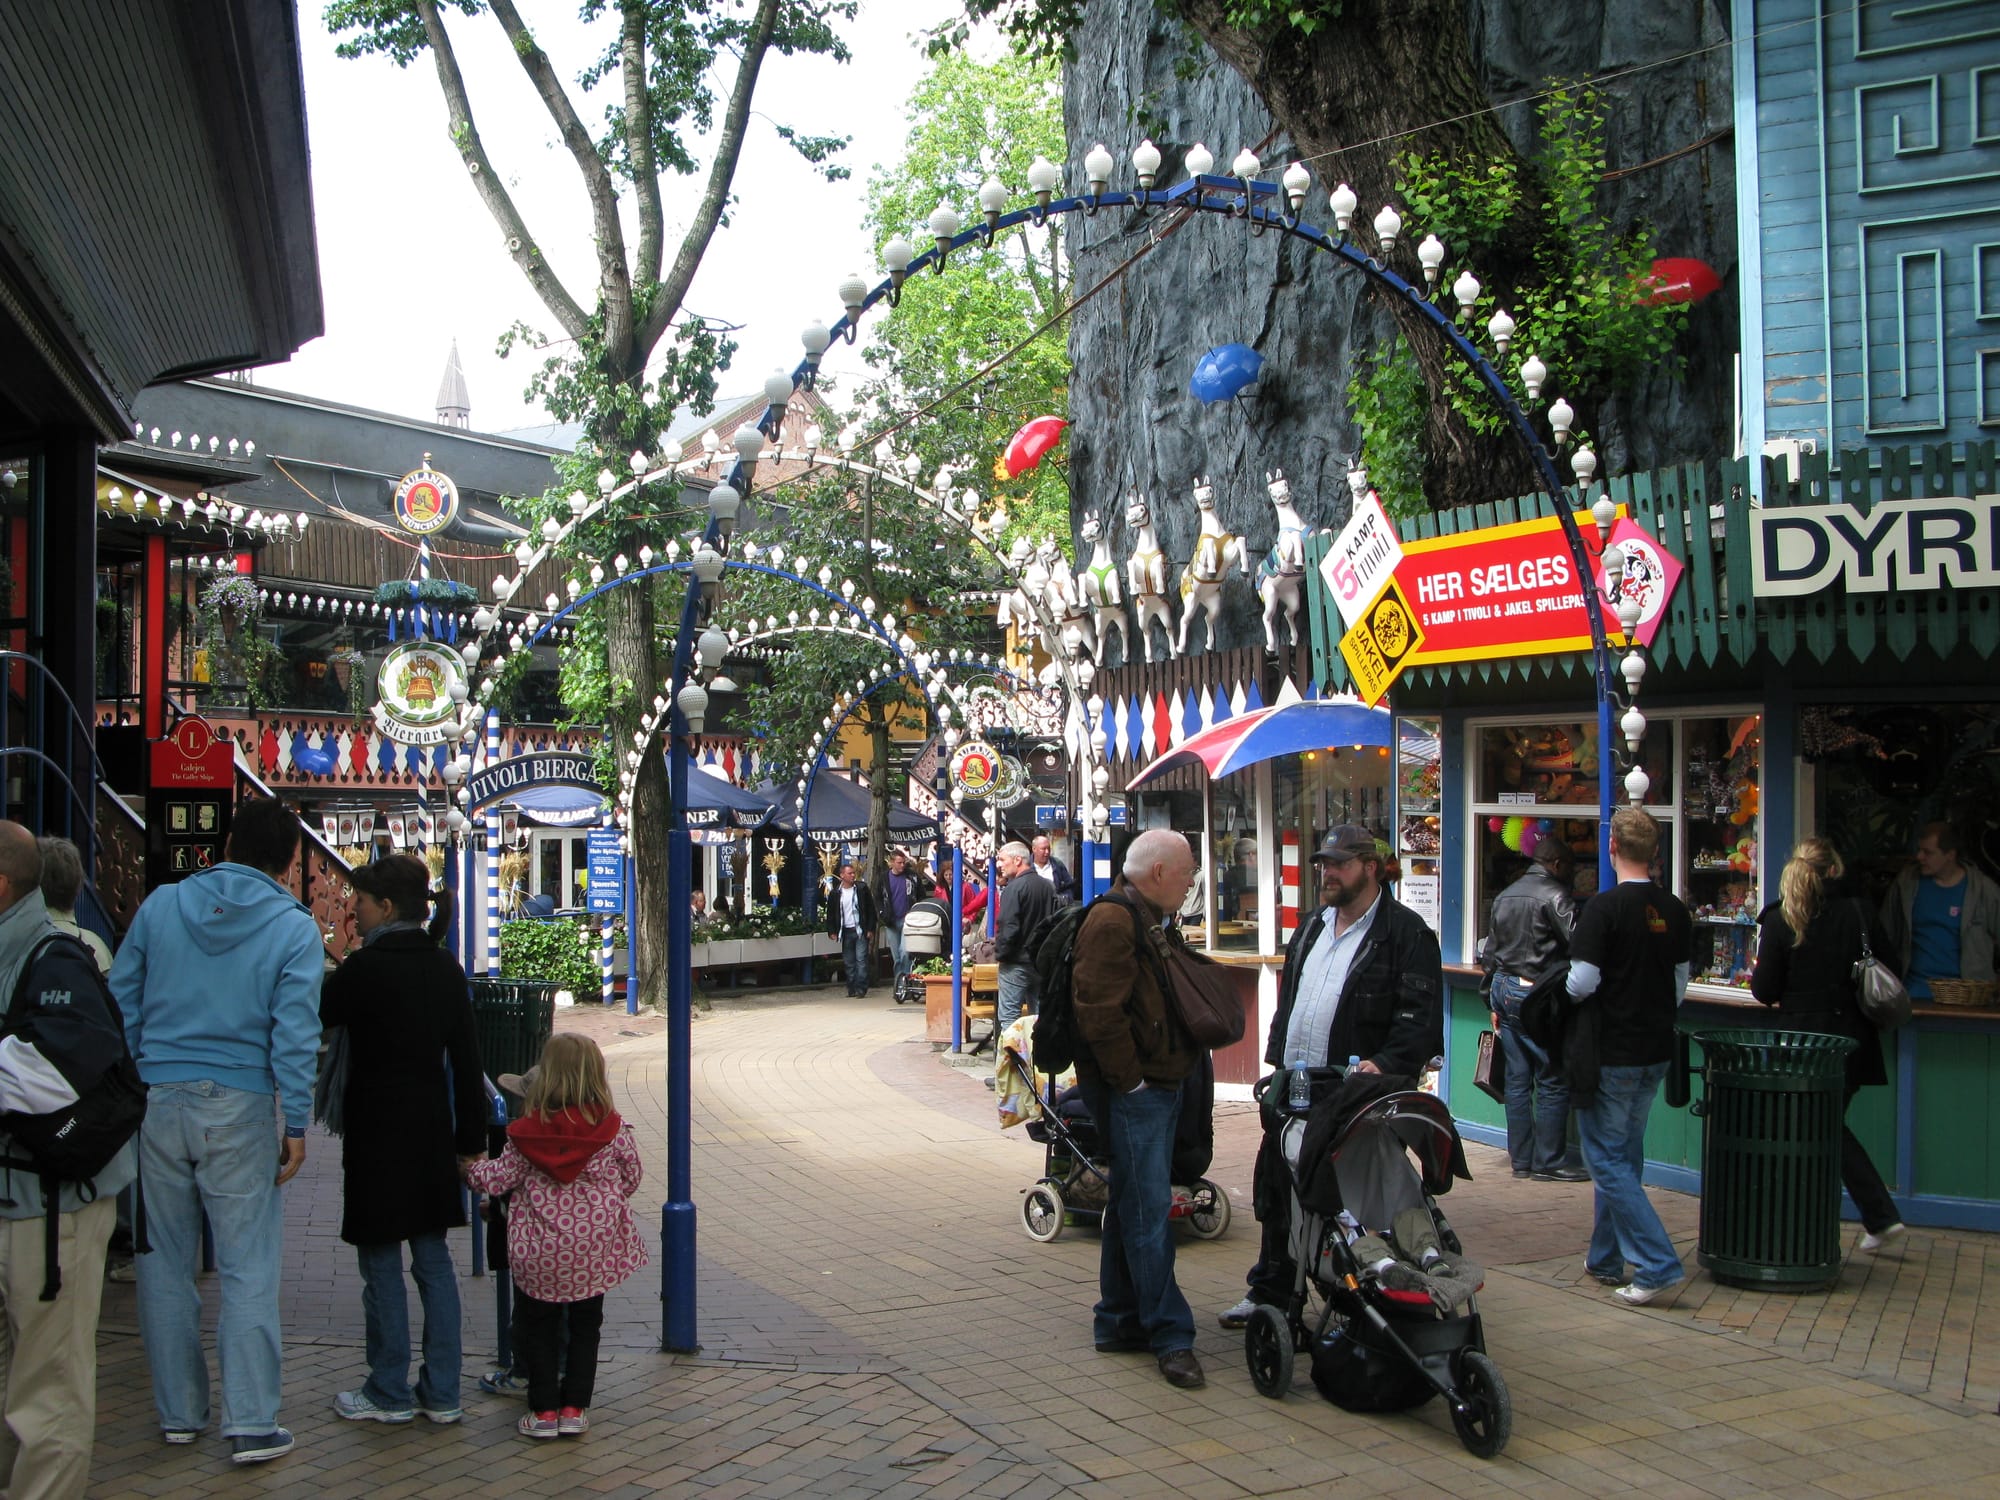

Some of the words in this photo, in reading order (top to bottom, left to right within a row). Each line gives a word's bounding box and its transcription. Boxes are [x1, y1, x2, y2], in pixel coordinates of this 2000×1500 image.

[398, 472, 449, 498] PAULANER
[1345, 513, 1376, 561] KAMP
[1762, 507, 2000, 582] DYR
[1332, 556, 1359, 601] 5
[1417, 571, 1464, 604] HER
[1470, 555, 1570, 597] SÆLGES
[1423, 613, 1430, 627] 5
[1431, 607, 1456, 625] KAMP
[1458, 610, 1461, 622] I
[1464, 604, 1491, 622] TIVOLI
[1494, 603, 1502, 617] &
[1504, 599, 1534, 616] JAKEL
[1349, 637, 1378, 694] SPILLEPAS
[1355, 629, 1386, 685] JAKEL
[471, 761, 528, 803] TIVOLI
[532, 758, 603, 787] BIERGA
[178, 814, 183, 823] 2
[594, 866, 604, 875] 79
[605, 866, 616, 875] kr.
[605, 899, 616, 908] kr.
[40, 990, 72, 1006] HH
[56, 1117, 78, 1139] TIGHT
